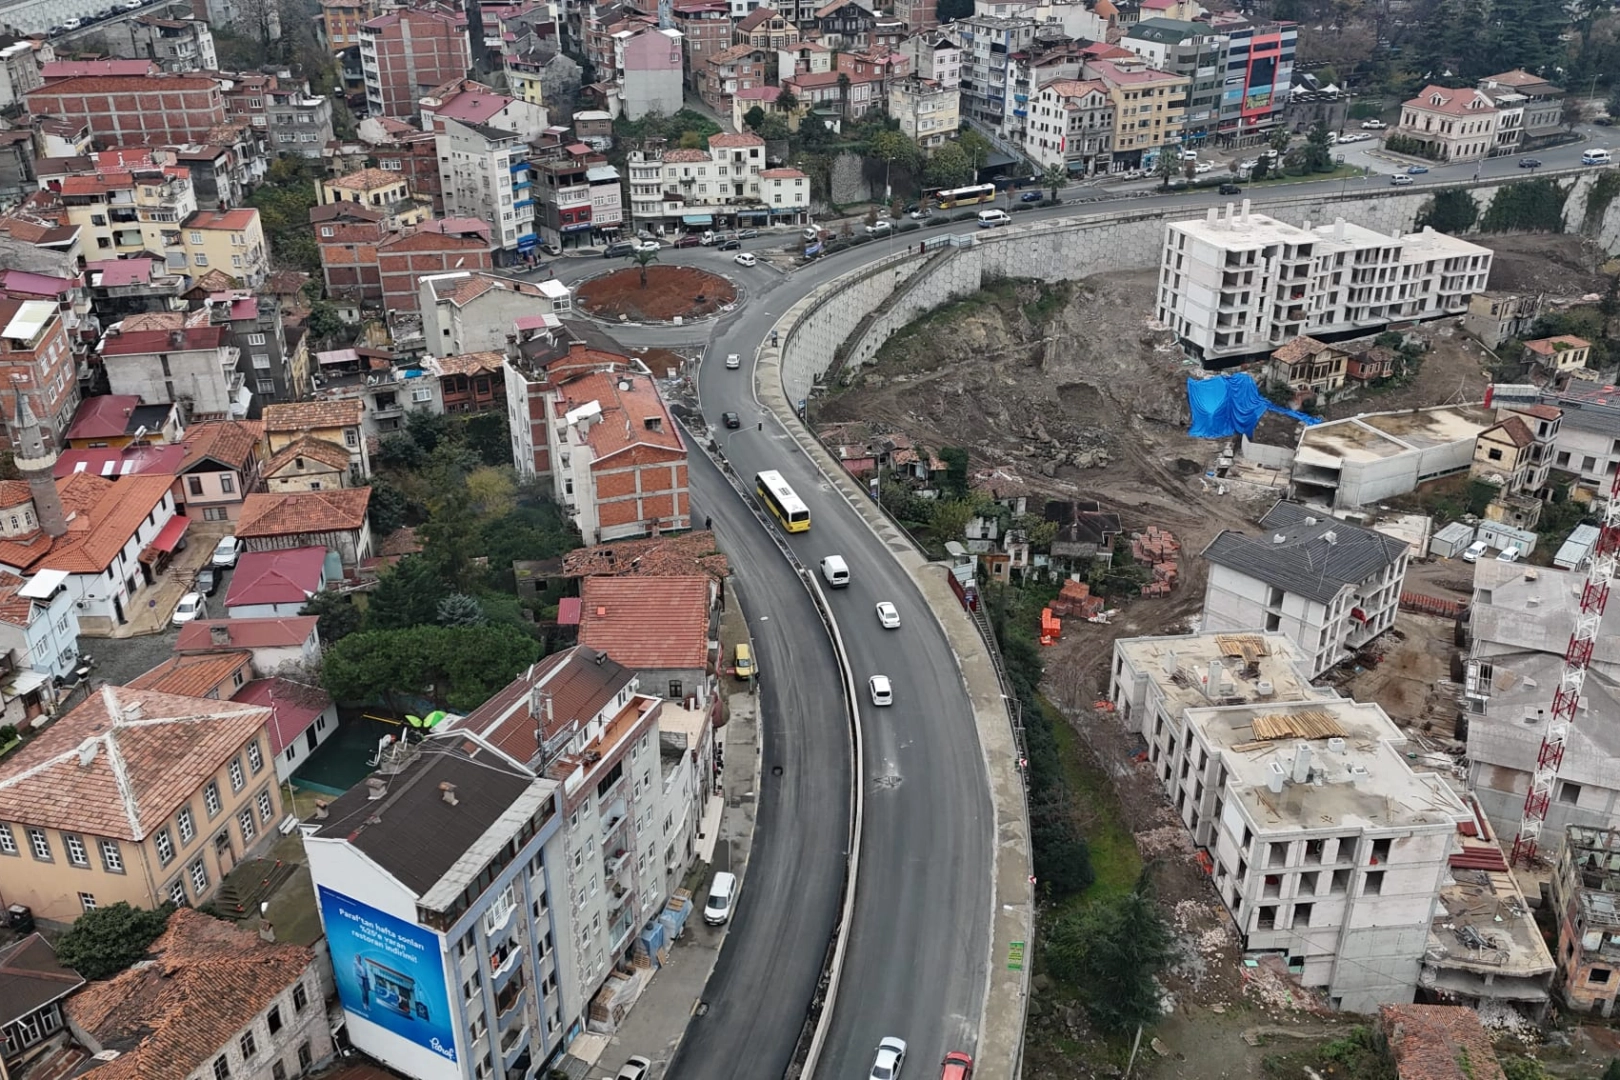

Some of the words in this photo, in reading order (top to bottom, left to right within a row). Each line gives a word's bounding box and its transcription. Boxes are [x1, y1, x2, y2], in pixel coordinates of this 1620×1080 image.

[338, 908, 374, 928] Paraf'tan
[375, 922, 397, 938] hafta
[398, 934, 425, 951] sonları
[351, 930, 384, 948] restoran
[384, 937, 407, 951] varan
[428, 1036, 454, 1060] Paraf
